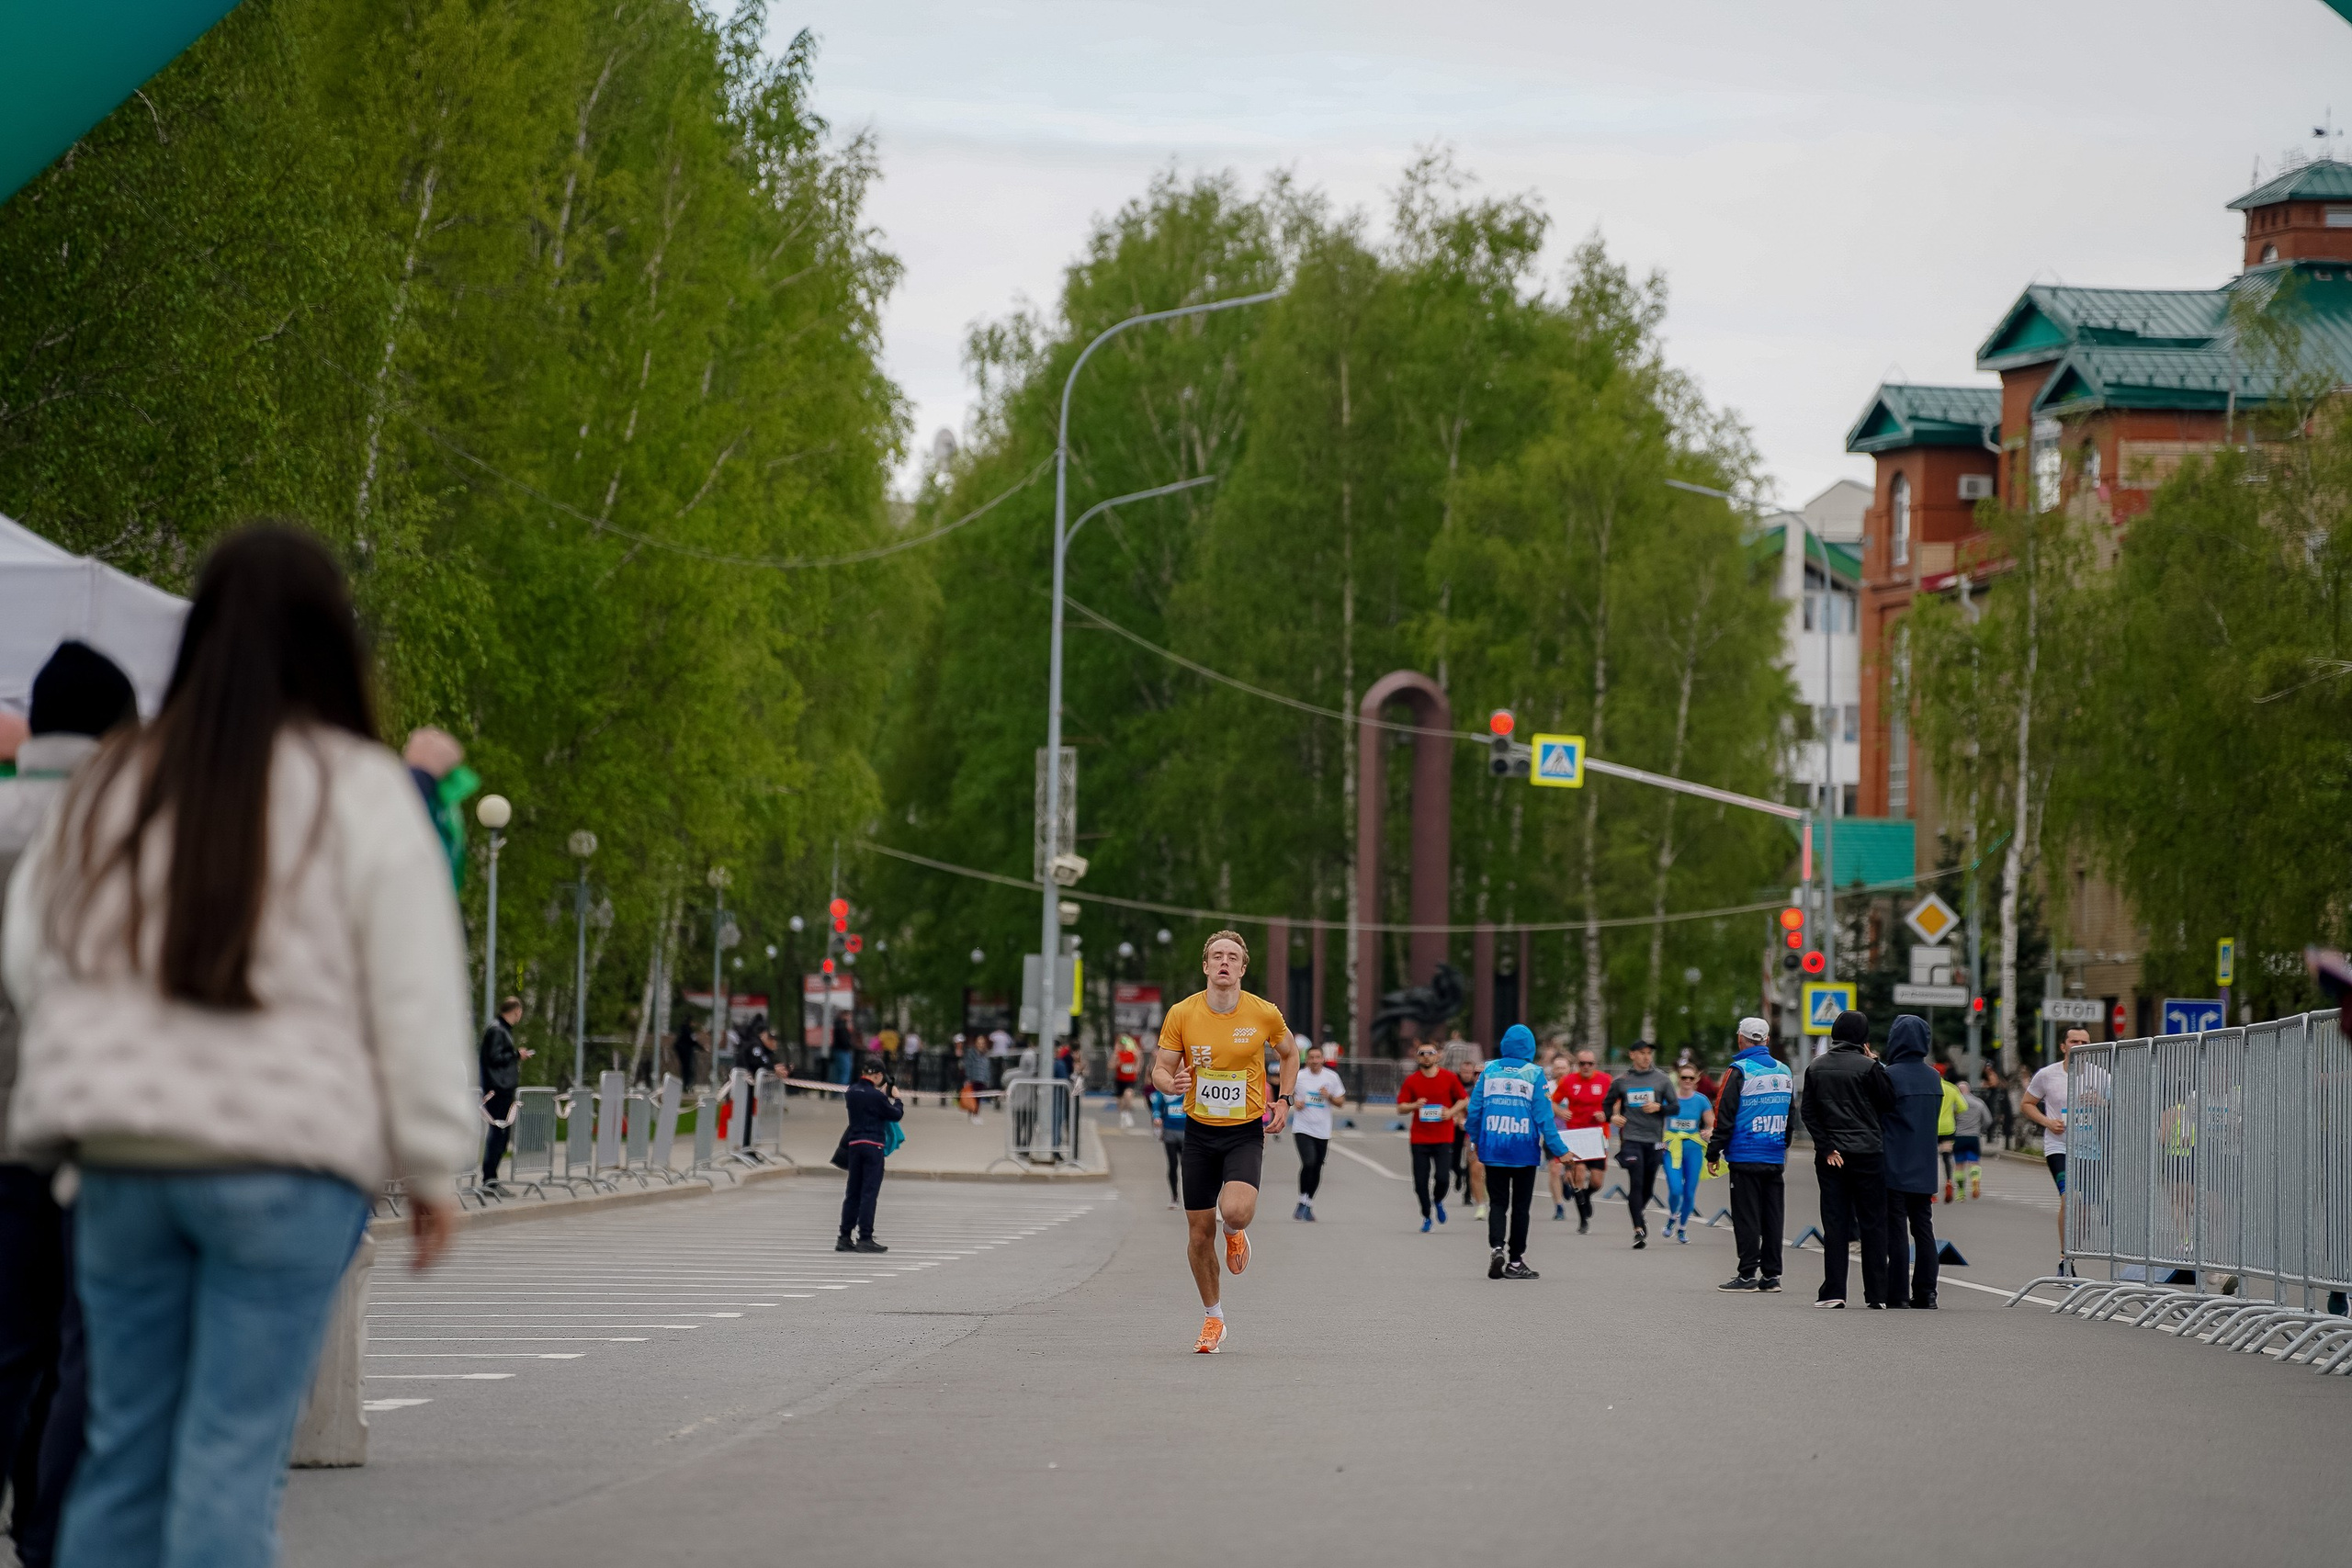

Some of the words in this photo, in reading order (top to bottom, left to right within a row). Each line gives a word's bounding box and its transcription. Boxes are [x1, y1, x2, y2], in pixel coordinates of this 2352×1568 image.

[2052, 1002, 2097, 1018] СТОП
[1201, 1085, 1240, 1100] 4003
[1572, 1084, 1582, 1096] 7
